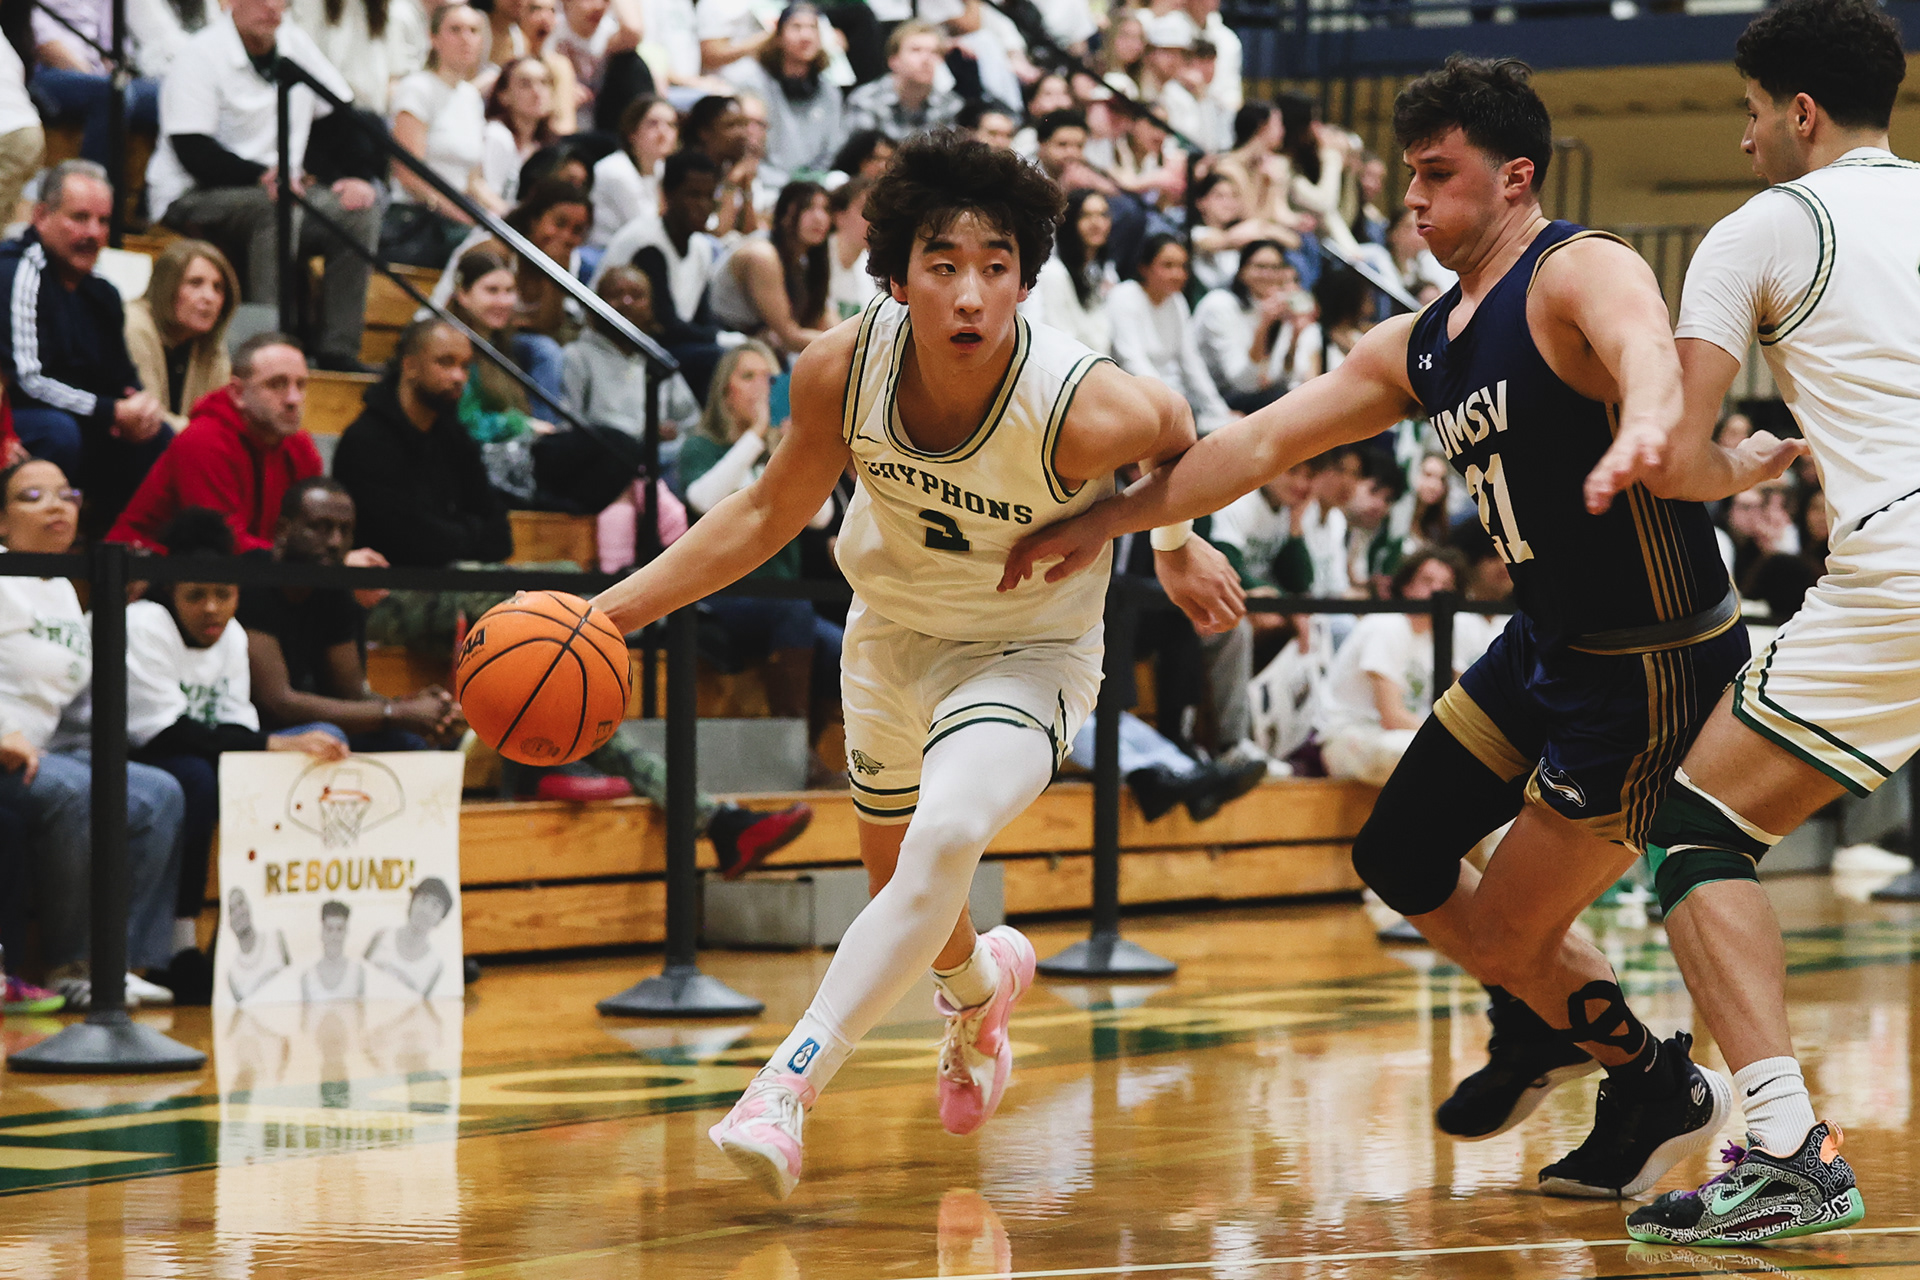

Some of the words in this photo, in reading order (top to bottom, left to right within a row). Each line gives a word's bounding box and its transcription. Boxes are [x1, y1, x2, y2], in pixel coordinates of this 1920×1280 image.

[1430, 379, 1508, 460] UMSV
[1465, 453, 1535, 564] 21
[265, 858, 416, 896] REBOUND!
[1759, 1217, 1797, 1238] HUSTLE
